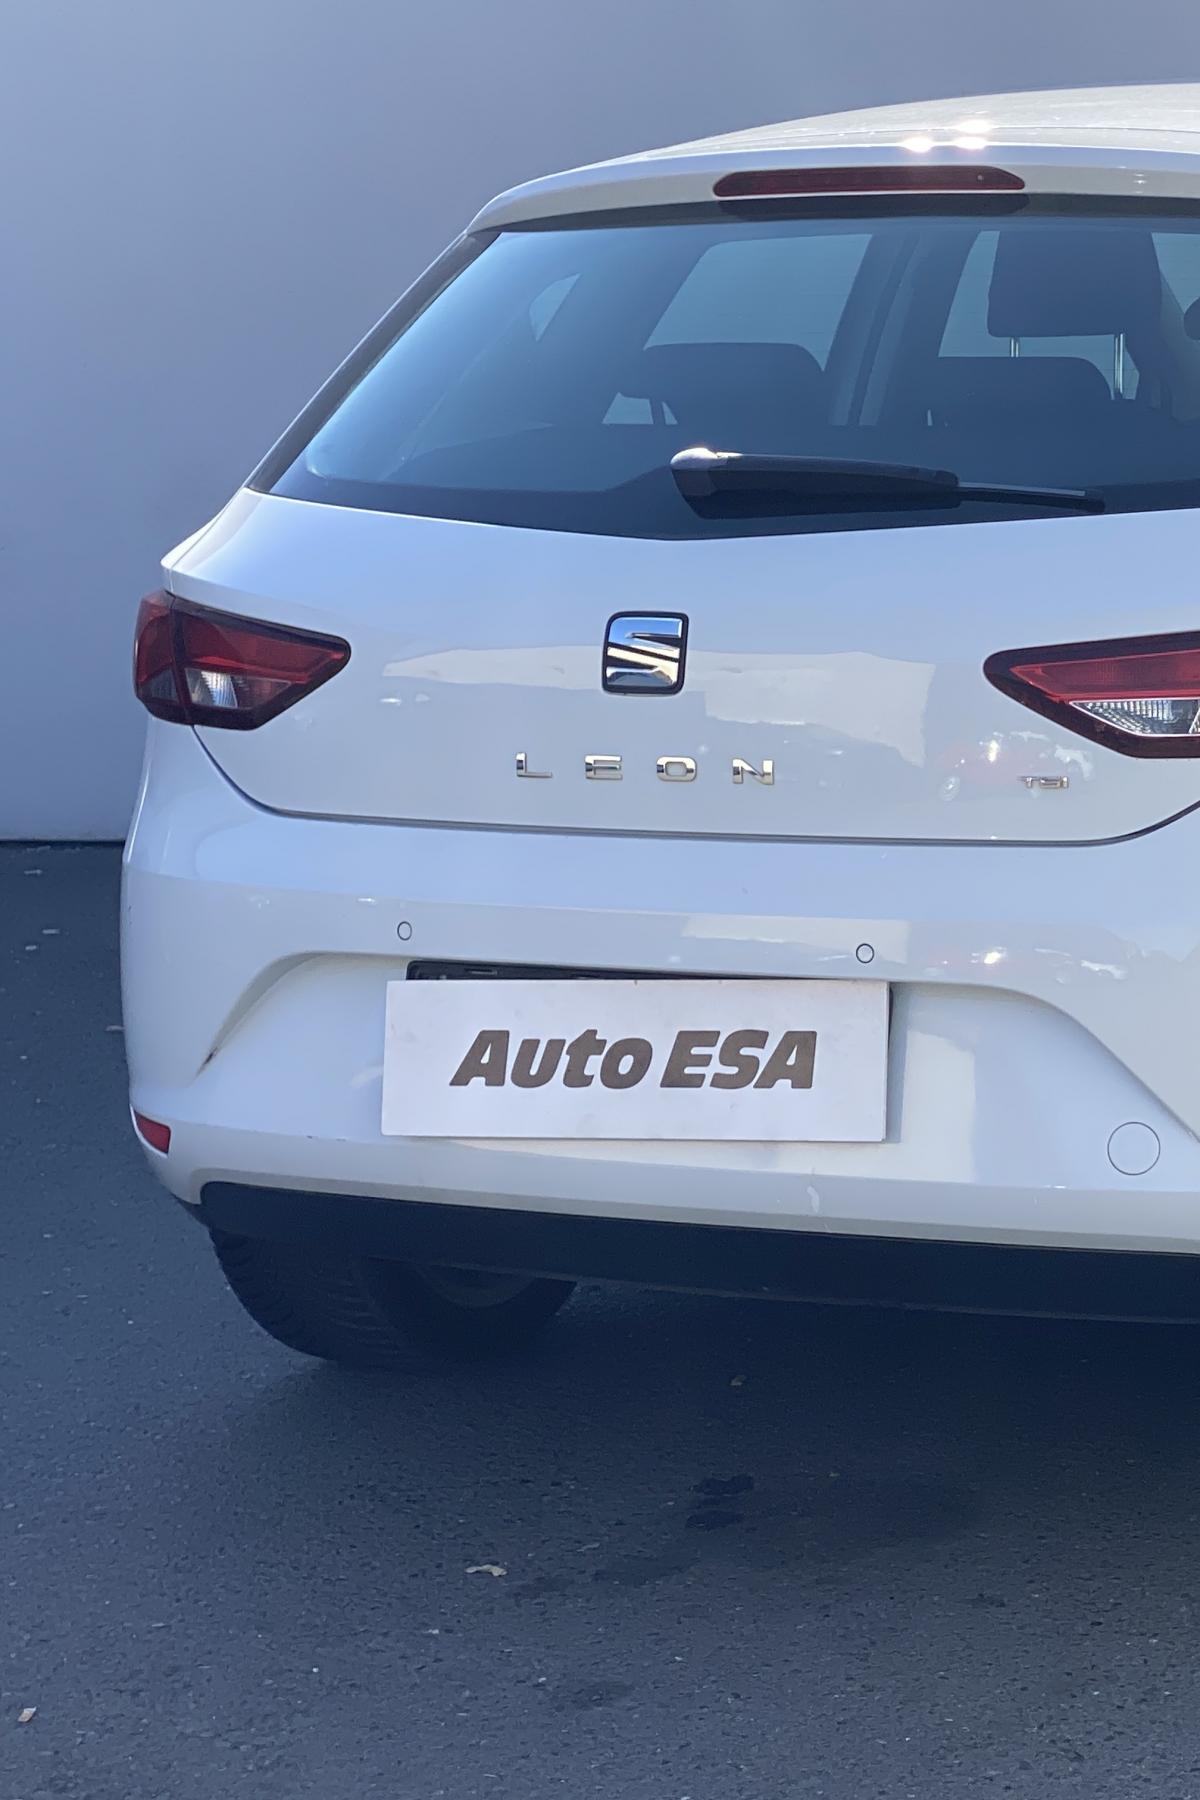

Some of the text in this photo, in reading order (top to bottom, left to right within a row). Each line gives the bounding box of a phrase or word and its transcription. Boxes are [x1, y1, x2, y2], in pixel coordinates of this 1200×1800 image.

[515, 752, 774, 785] LEON
[449, 1029, 818, 1090] Auto ESA
